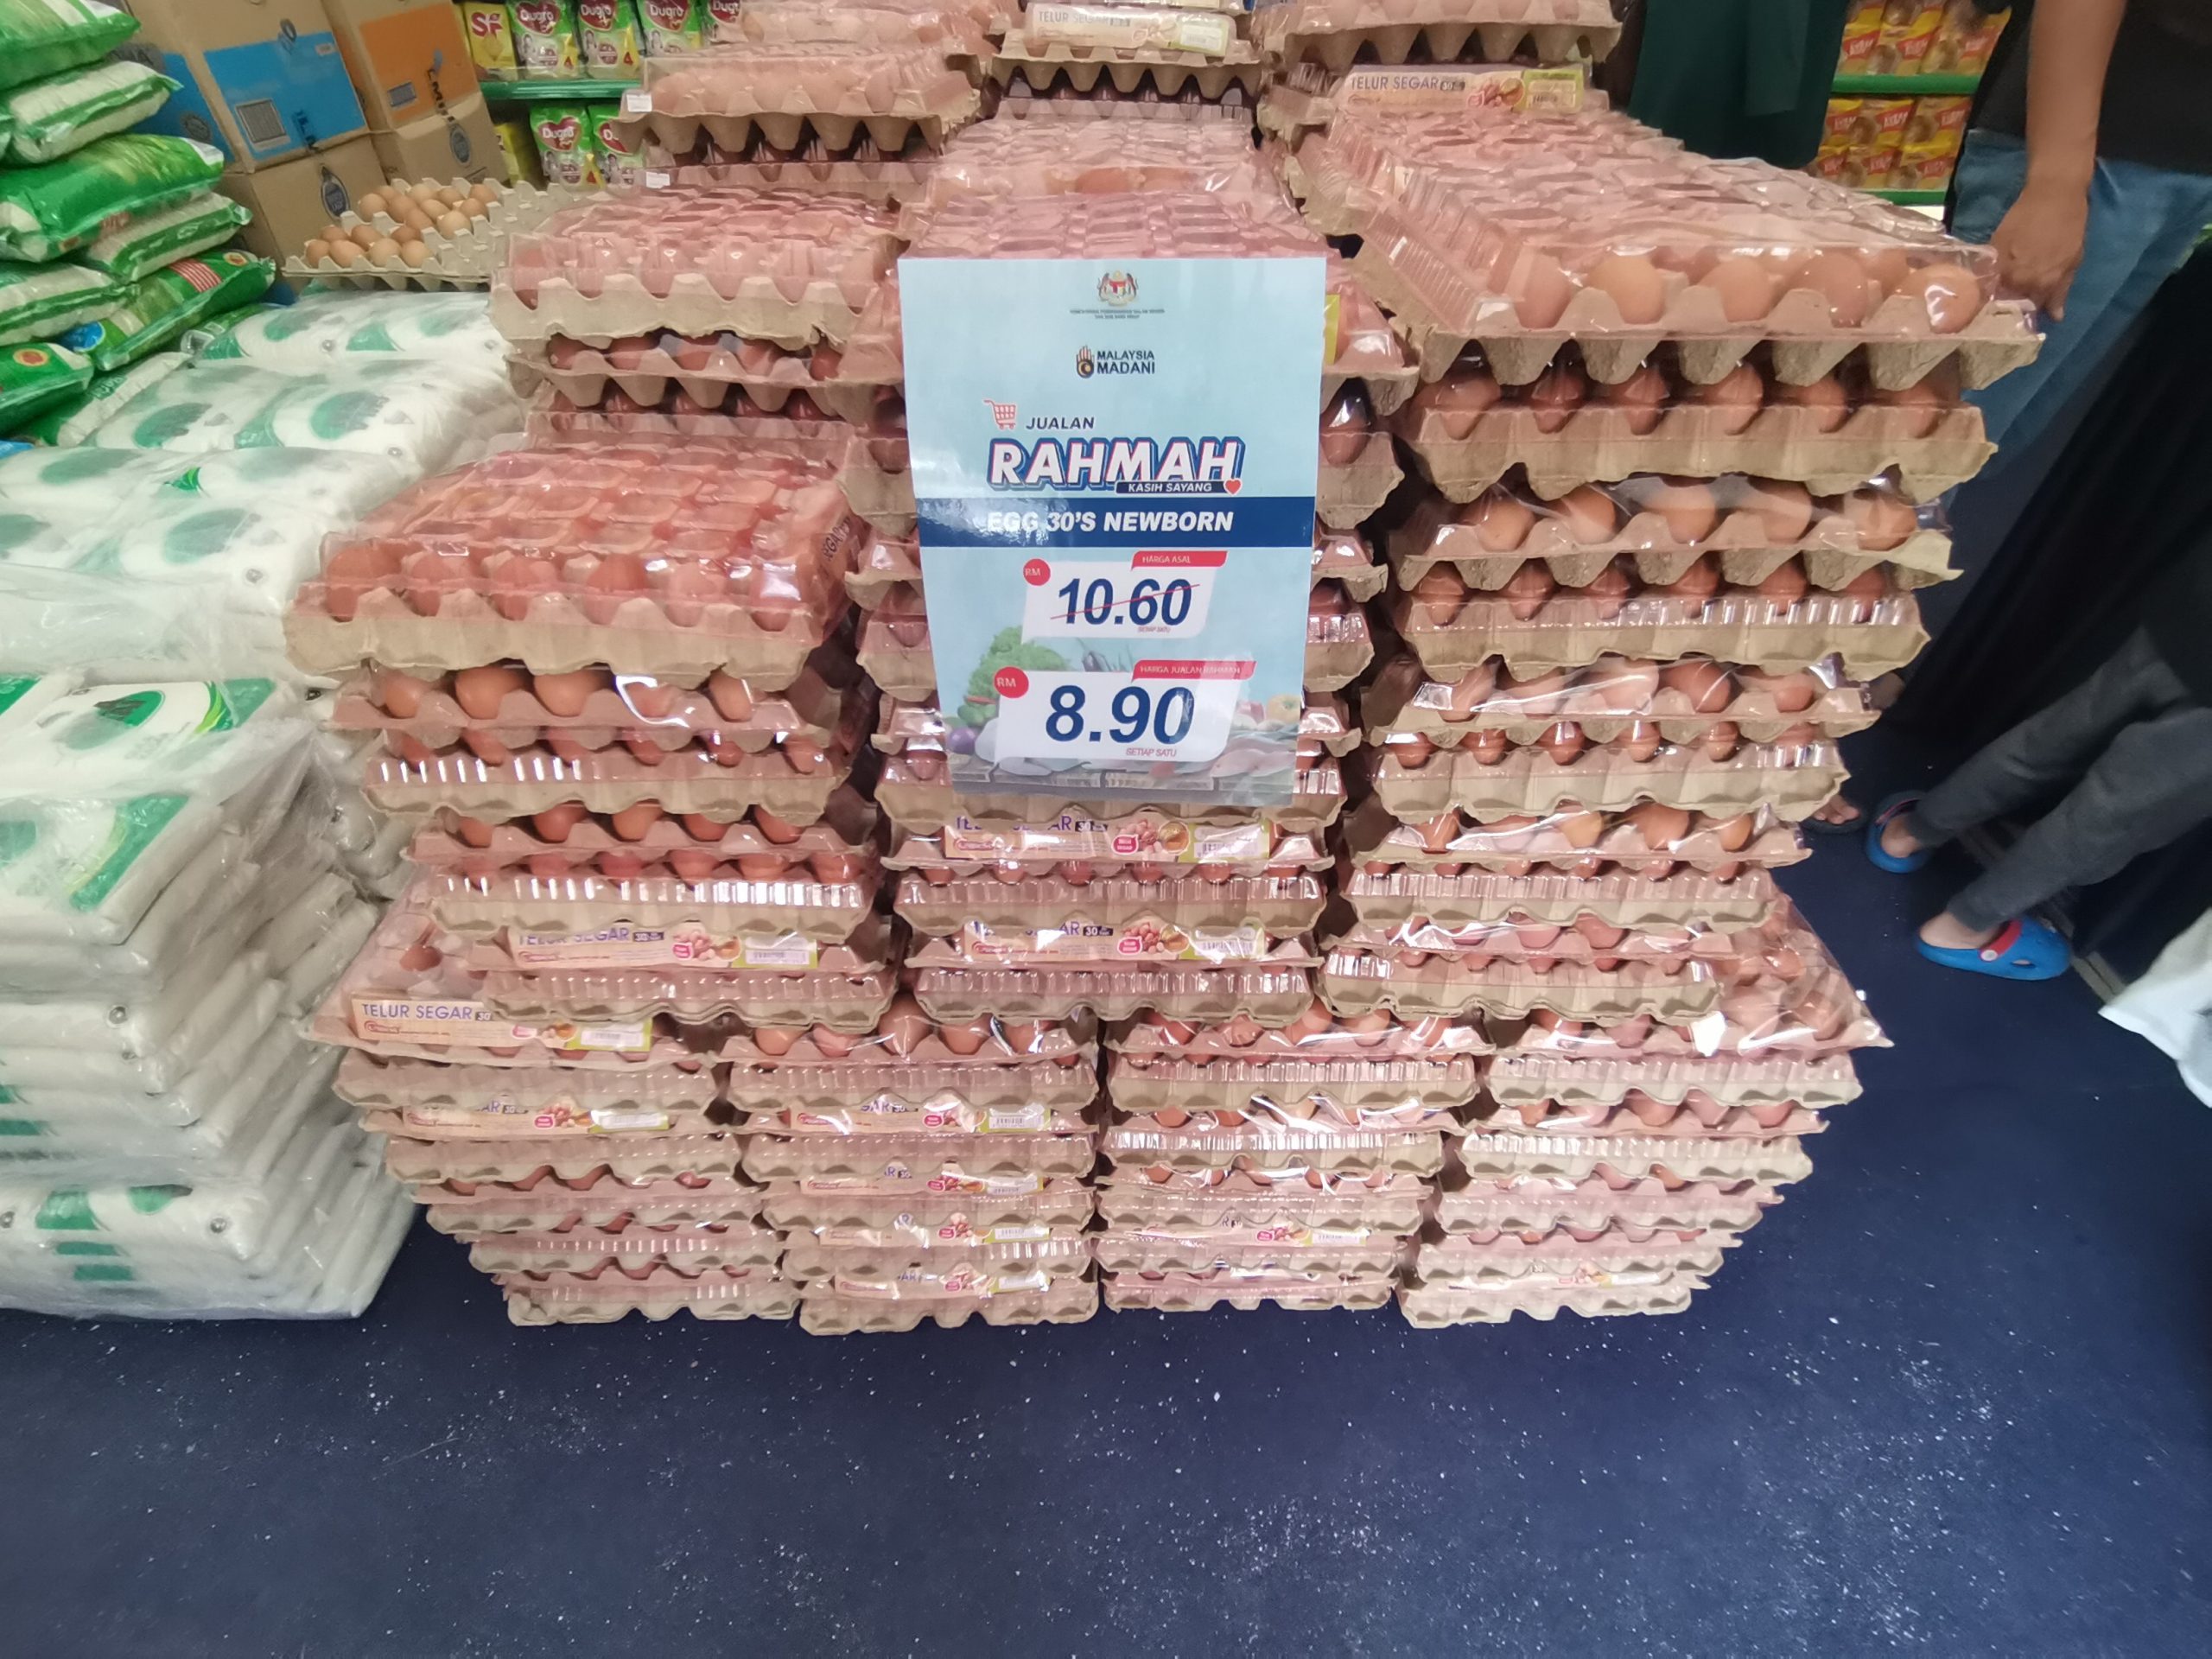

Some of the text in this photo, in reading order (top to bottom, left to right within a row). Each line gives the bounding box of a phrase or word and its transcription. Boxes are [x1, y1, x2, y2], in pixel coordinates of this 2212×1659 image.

[650, 4, 684, 20] Dugro
[1039, 11, 1069, 22] TELUR
[1351, 76, 1389, 90] TELUR
[1393, 76, 1440, 89] SEGAR
[1096, 350, 1155, 360] MALAYSIA
[1096, 361, 1155, 374] MADANI
[1026, 416, 1096, 431] JUALAN
[988, 437, 1245, 492] RAHMAH
[1128, 482, 1213, 493] KASIH SAYANG
[987, 511, 1038, 532] EGG
[1103, 511, 1234, 532] NEWBORN
[1025, 568, 1041, 577] RM
[1058, 577, 1192, 626] 10.60
[1171, 666, 1202, 675] JUALAN
[995, 677, 1017, 688] RM
[1045, 684, 1195, 745] 8.90
[1155, 748, 1178, 757] SATU
[1084, 926, 1098, 936] 30
[361, 1003, 410, 1018] TELUR
[416, 1006, 473, 1020] SEGAR
